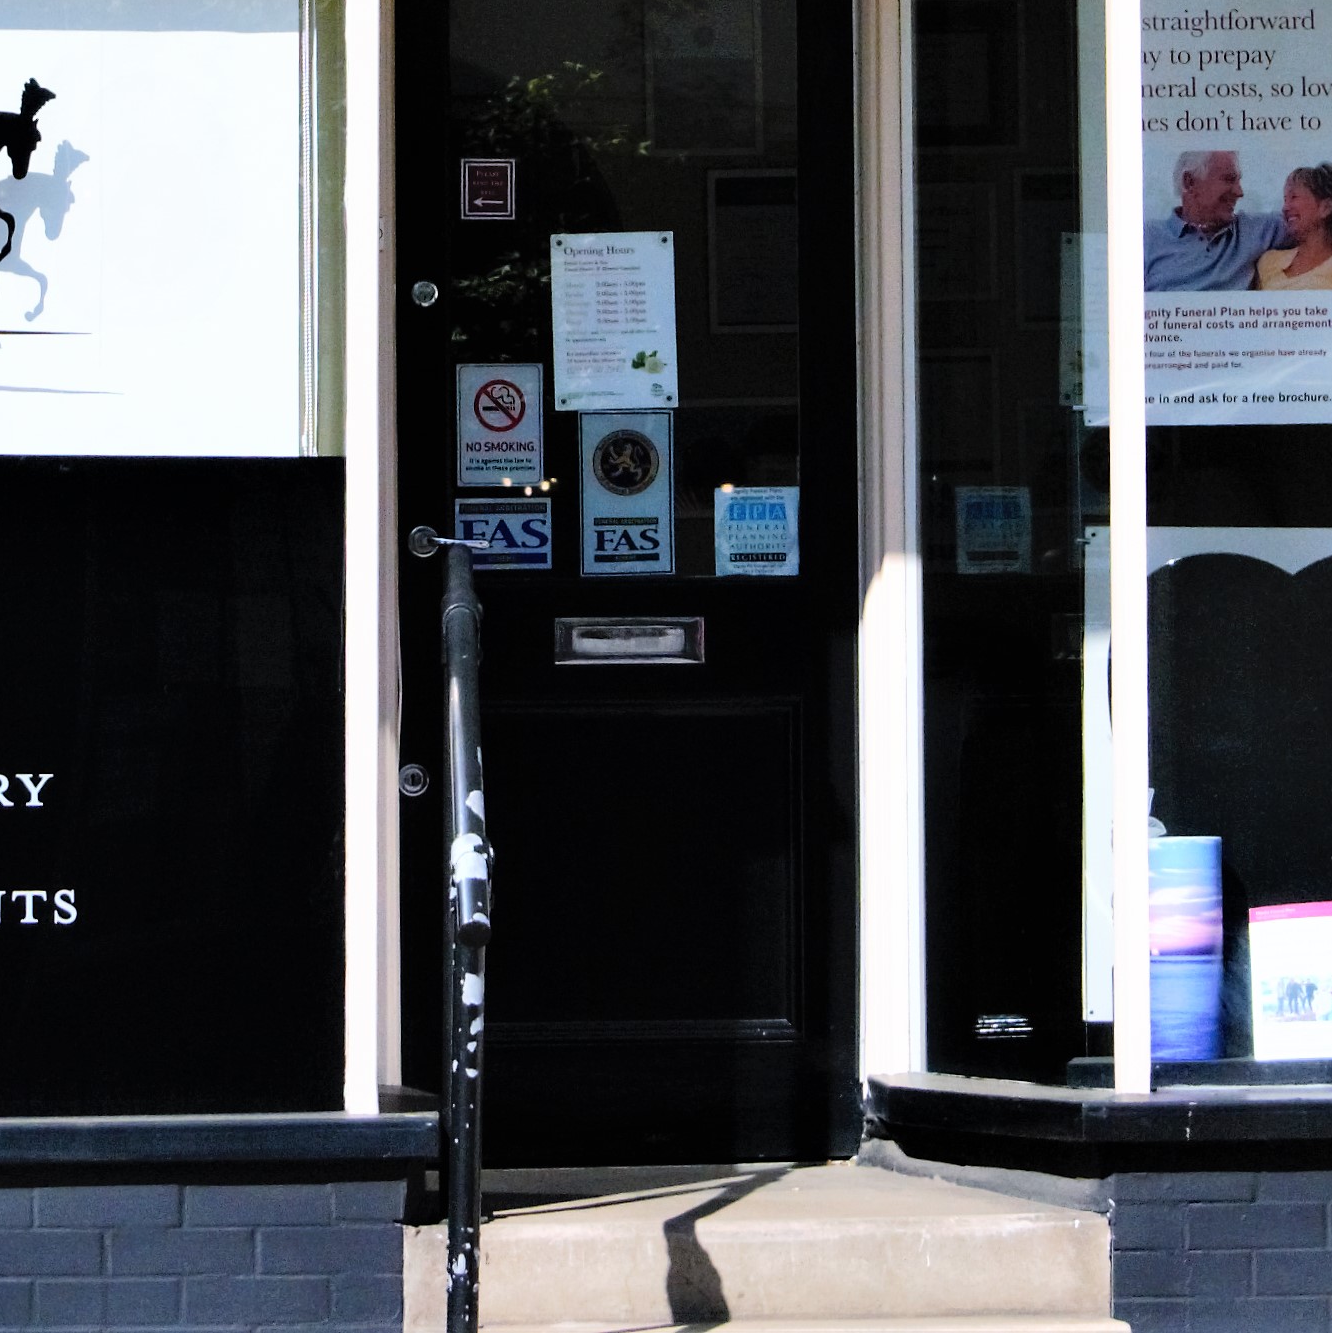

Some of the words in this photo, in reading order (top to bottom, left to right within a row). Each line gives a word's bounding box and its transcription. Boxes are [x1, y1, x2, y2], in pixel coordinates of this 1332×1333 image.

[1142, 8, 1316, 38] straightforward
[1170, 48, 1191, 65] to
[1199, 50, 1276, 72] prepay
[1142, 76, 1197, 98] neral
[1204, 76, 1264, 100] costs,
[1270, 83, 1294, 97] so
[1176, 110, 1237, 131] don't
[1241, 109, 1292, 131] have
[1300, 114, 1322, 131] to
[563, 246, 604, 258] Opening
[606, 245, 635, 256] Hours
[1175, 307, 1216, 317] Funeral
[1220, 306, 1246, 316] Plan
[1249, 306, 1279, 319] helps
[1282, 308, 1301, 319] you
[1305, 306, 1328, 316] take
[1148, 320, 1159, 330] of
[1163, 320, 1202, 330] funeral
[1206, 319, 1234, 329] costs
[1239, 319, 1258, 329] and
[1159, 393, 1170, 404] in
[1174, 393, 1195, 404] and
[1198, 393, 1219, 404] ask
[1222, 393, 1238, 404] for
[1242, 395, 1249, 403] a
[1252, 392, 1275, 403] free
[1278, 392, 1332, 403] brochure.
[466, 442, 482, 452] NO
[459, 518, 549, 549] FAS
[594, 528, 660, 552] FAS
